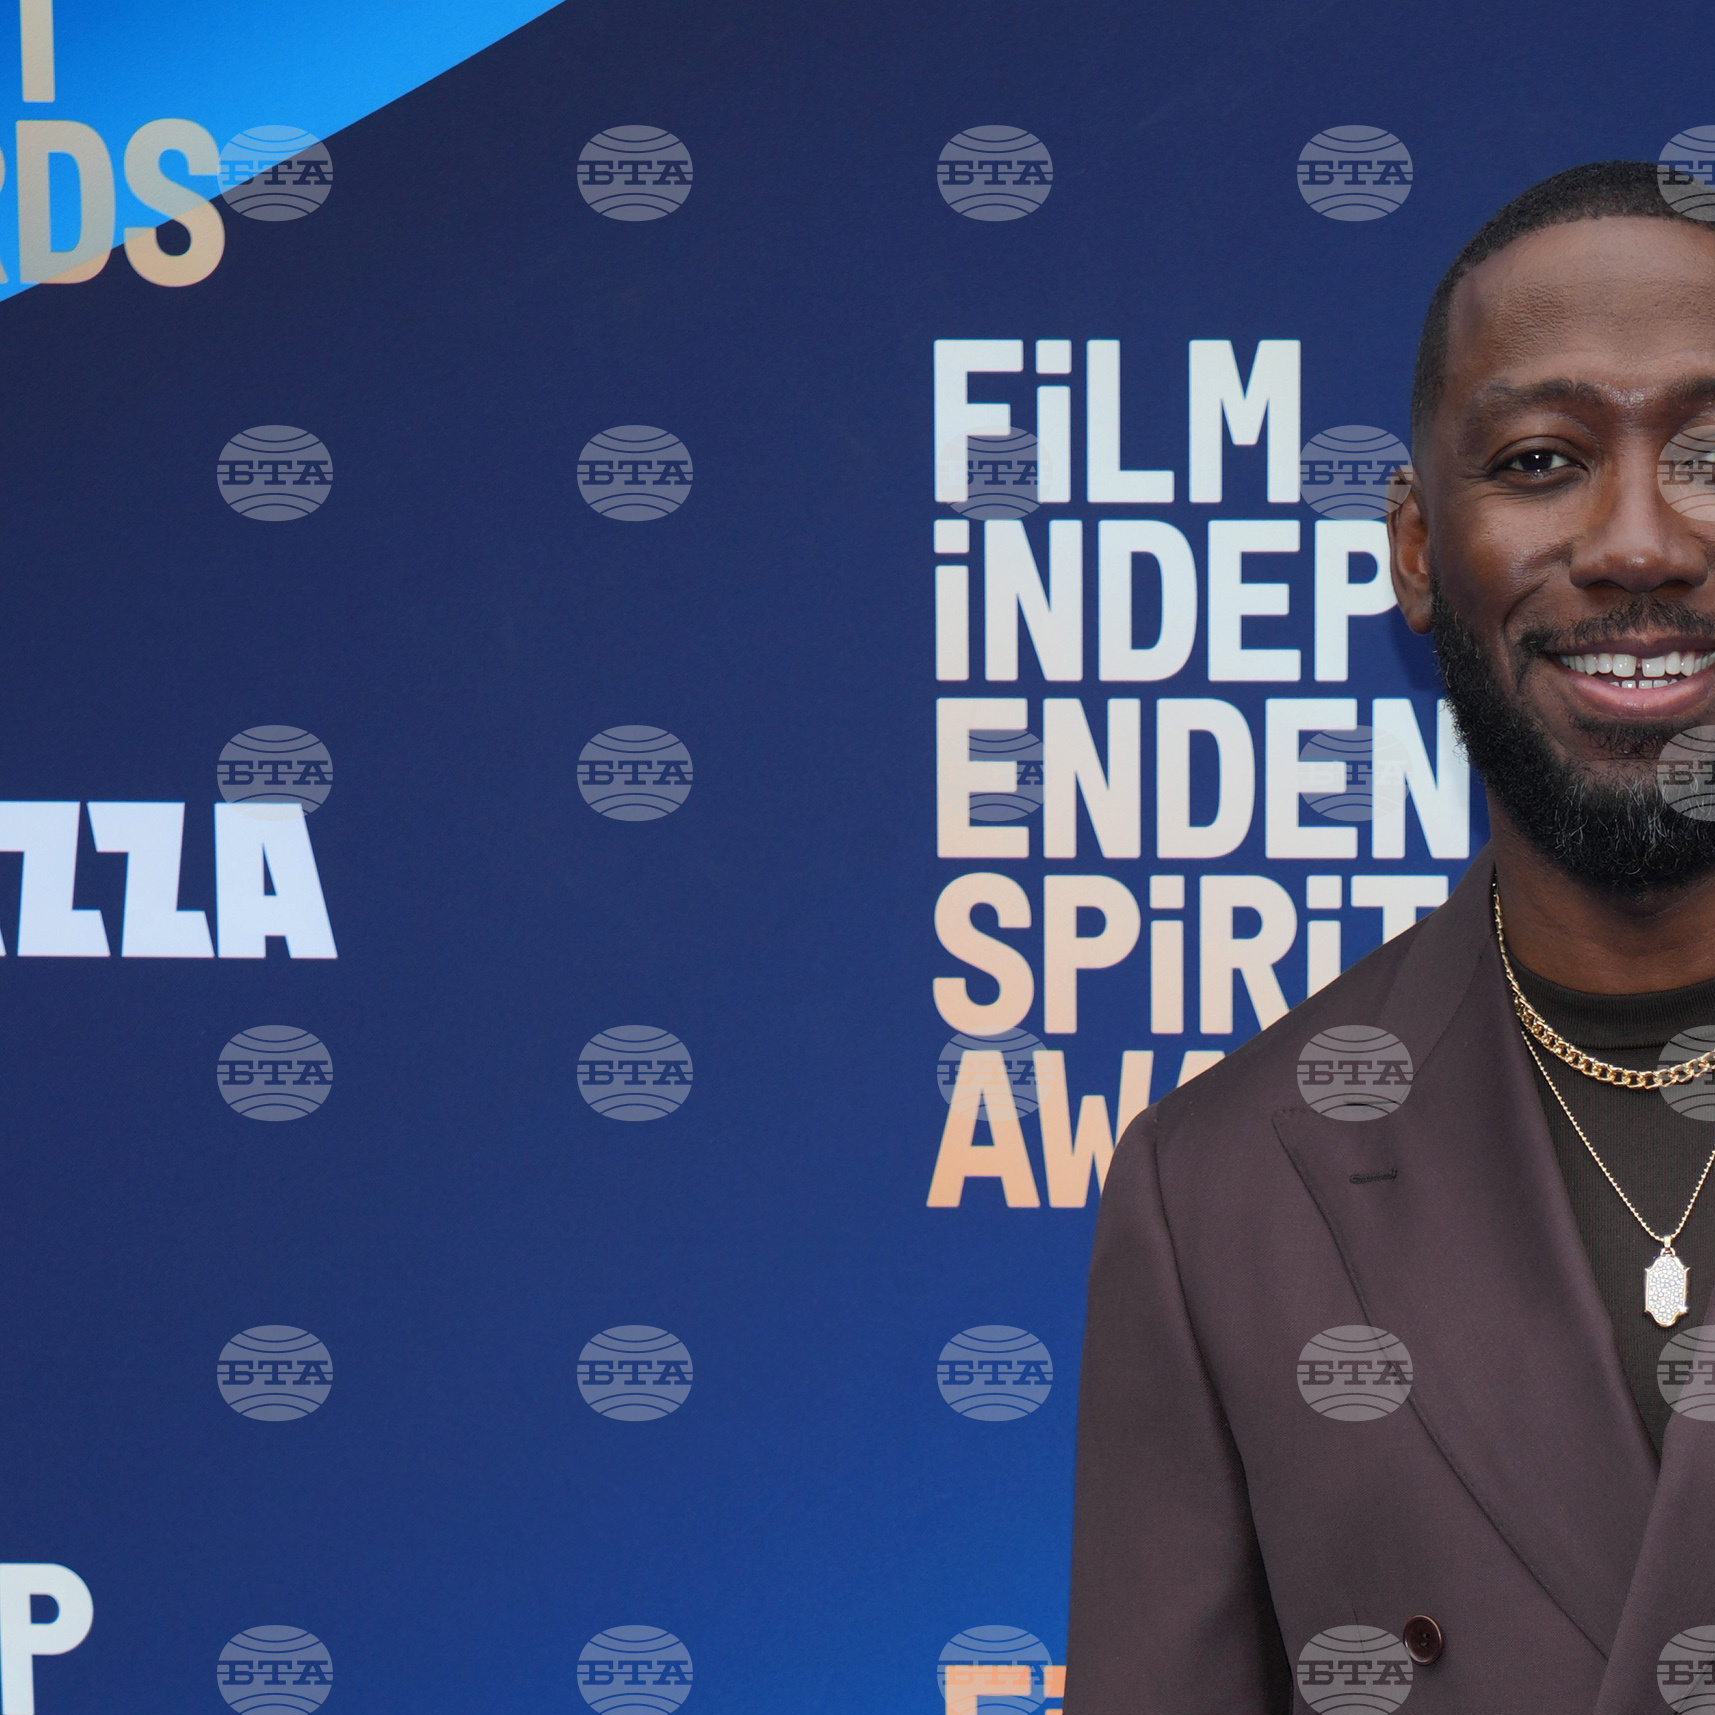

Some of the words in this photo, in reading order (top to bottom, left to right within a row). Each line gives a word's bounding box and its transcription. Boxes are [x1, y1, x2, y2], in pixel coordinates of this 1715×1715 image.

[0, 118, 226, 287] DS
[933, 339, 1302, 504] FiLM
[0, 800, 338, 959] ZZA
[926, 1050, 1226, 1208] AW
